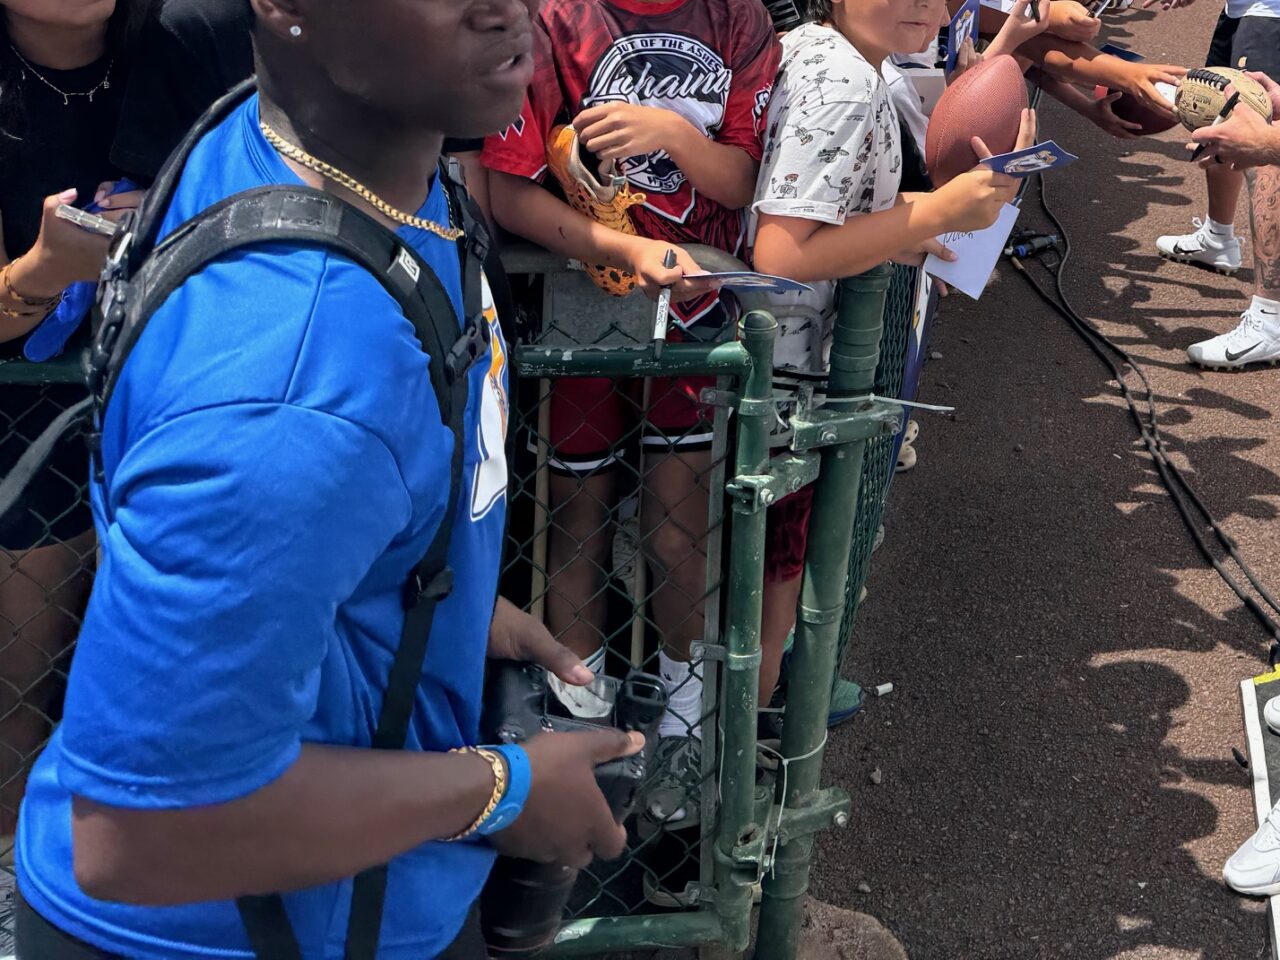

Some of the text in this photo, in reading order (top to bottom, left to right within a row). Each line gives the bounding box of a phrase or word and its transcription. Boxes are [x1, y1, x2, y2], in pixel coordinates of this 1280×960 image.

[640, 39, 656, 48] OF
[660, 39, 684, 51] THE
[687, 44, 722, 74] ASHES
